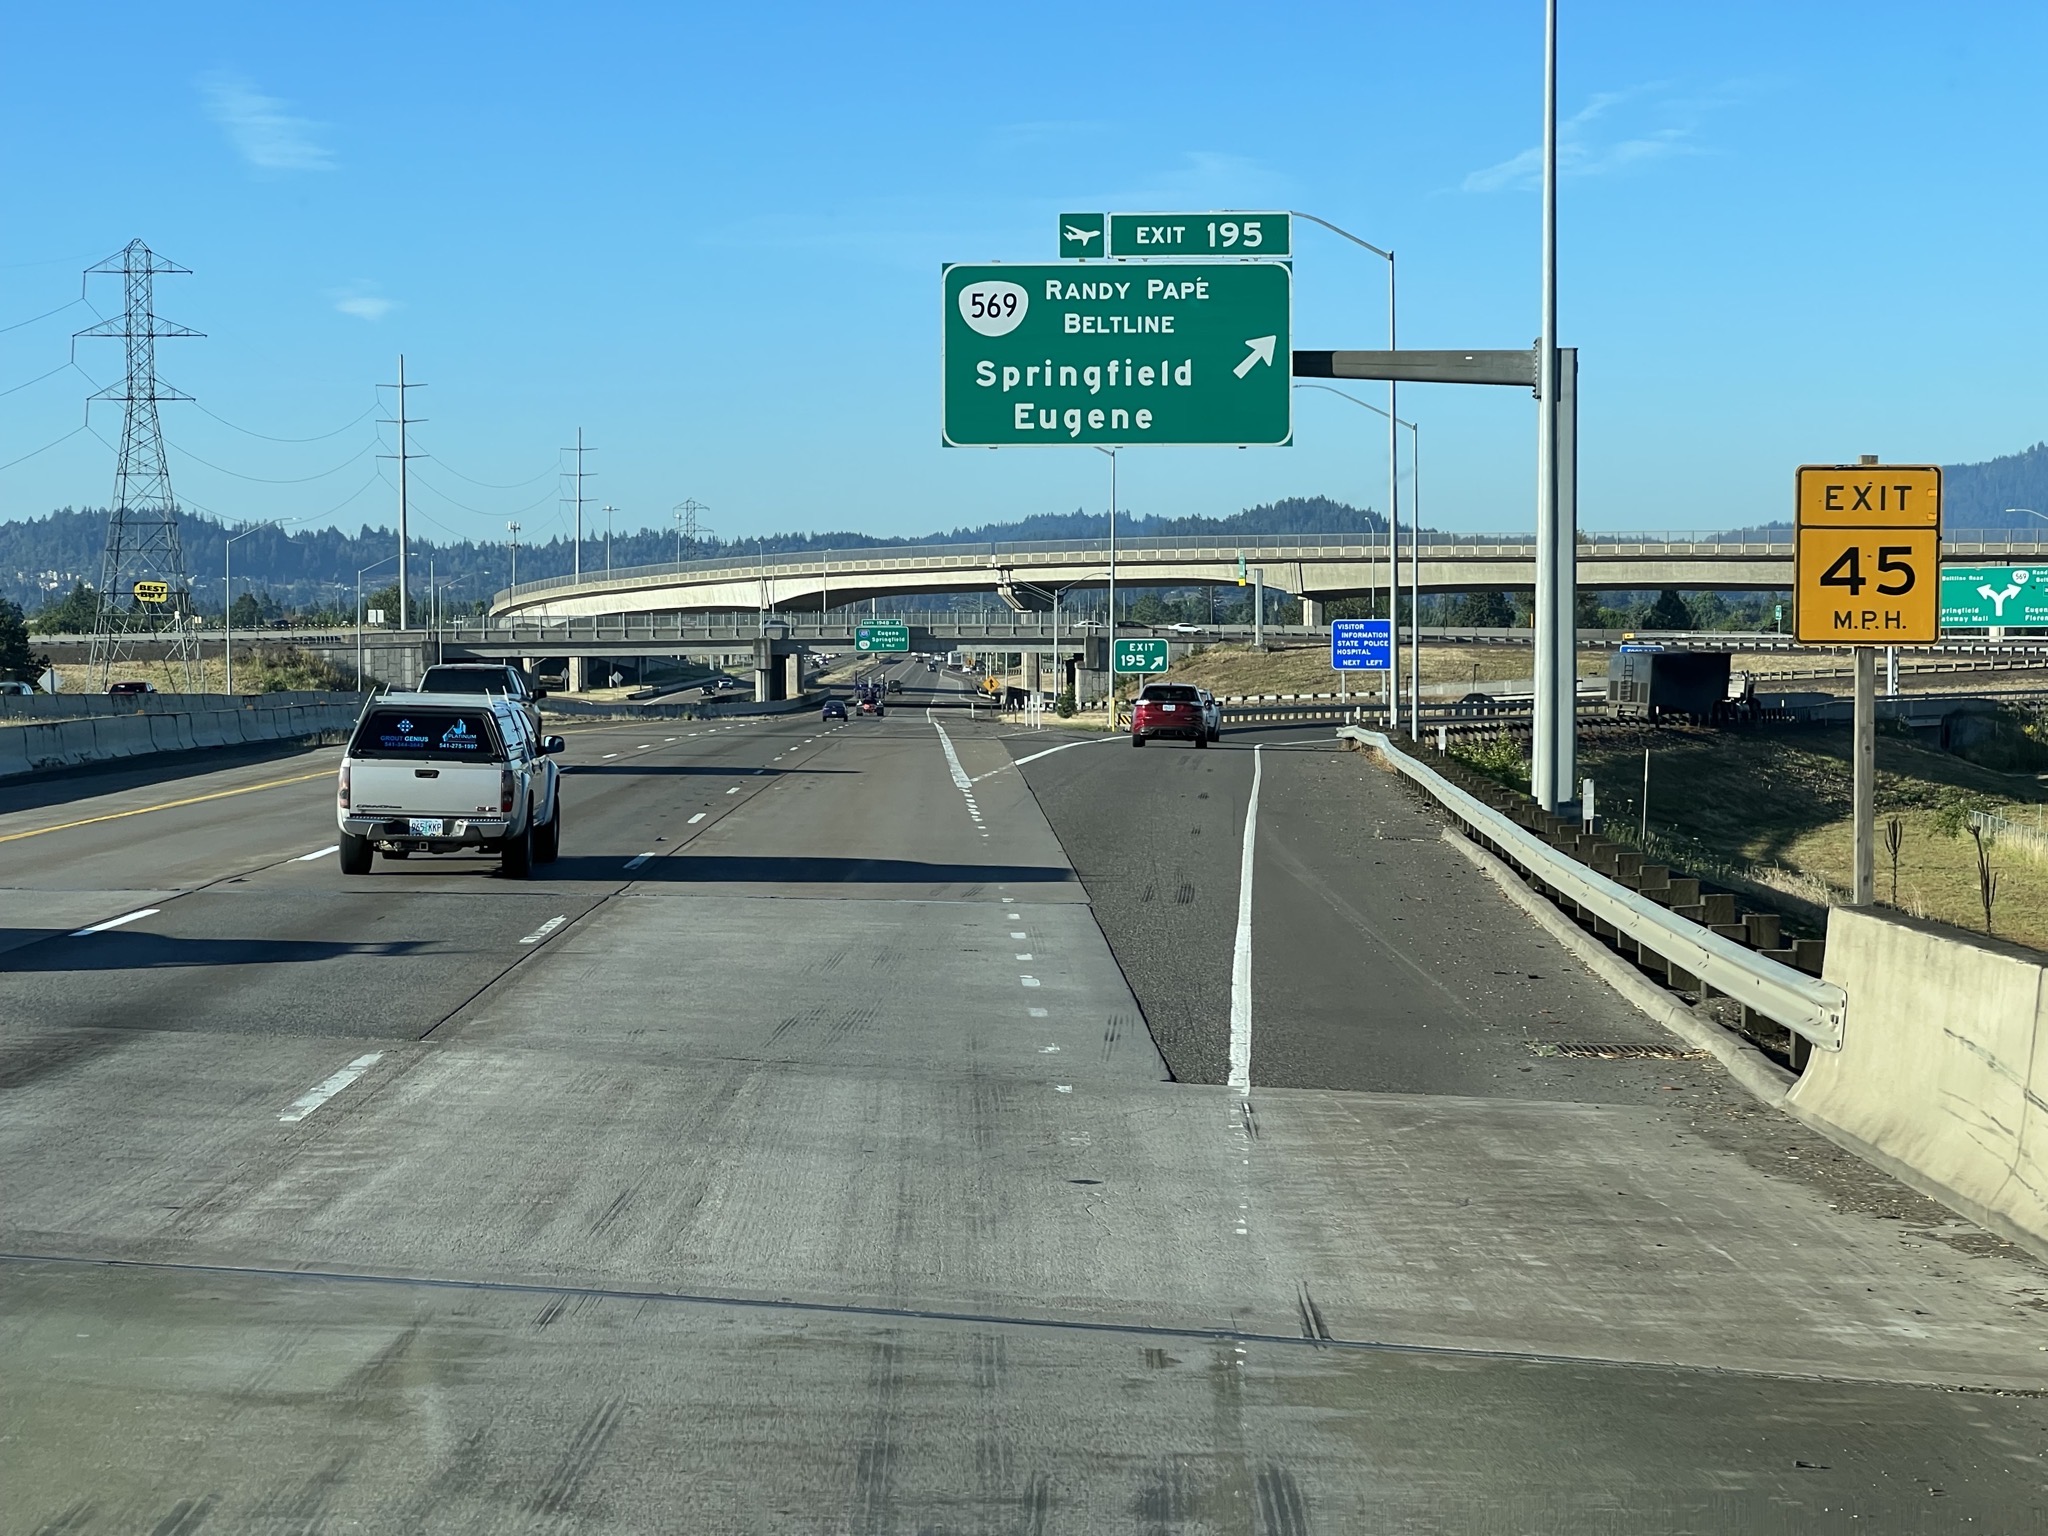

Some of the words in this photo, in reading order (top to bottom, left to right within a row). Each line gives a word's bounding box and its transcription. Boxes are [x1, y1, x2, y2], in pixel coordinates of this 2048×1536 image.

[1136, 226, 1185, 244] EXIT
[1207, 222, 1262, 247] 195
[1045, 279, 1130, 300] RANDY
[1147, 277, 1209, 300] PAPÉ
[970, 292, 1017, 318] 569
[1064, 313, 1174, 333] BELTLINE
[976, 359, 1192, 394] Springfield
[1015, 403, 1153, 437] Eugene
[1825, 485, 1912, 511] EXIT
[1820, 546, 1915, 596] 45
[2015, 572, 2027, 580] 569
[1834, 610, 1906, 629] M.P.H.
[1941, 607, 1979, 615] pringfield
[1941, 615, 1969, 623] ateway
[2024, 606, 2048, 614] Eugen
[1129, 643, 1155, 652] EXIT
[1120, 654, 1146, 667] 195
